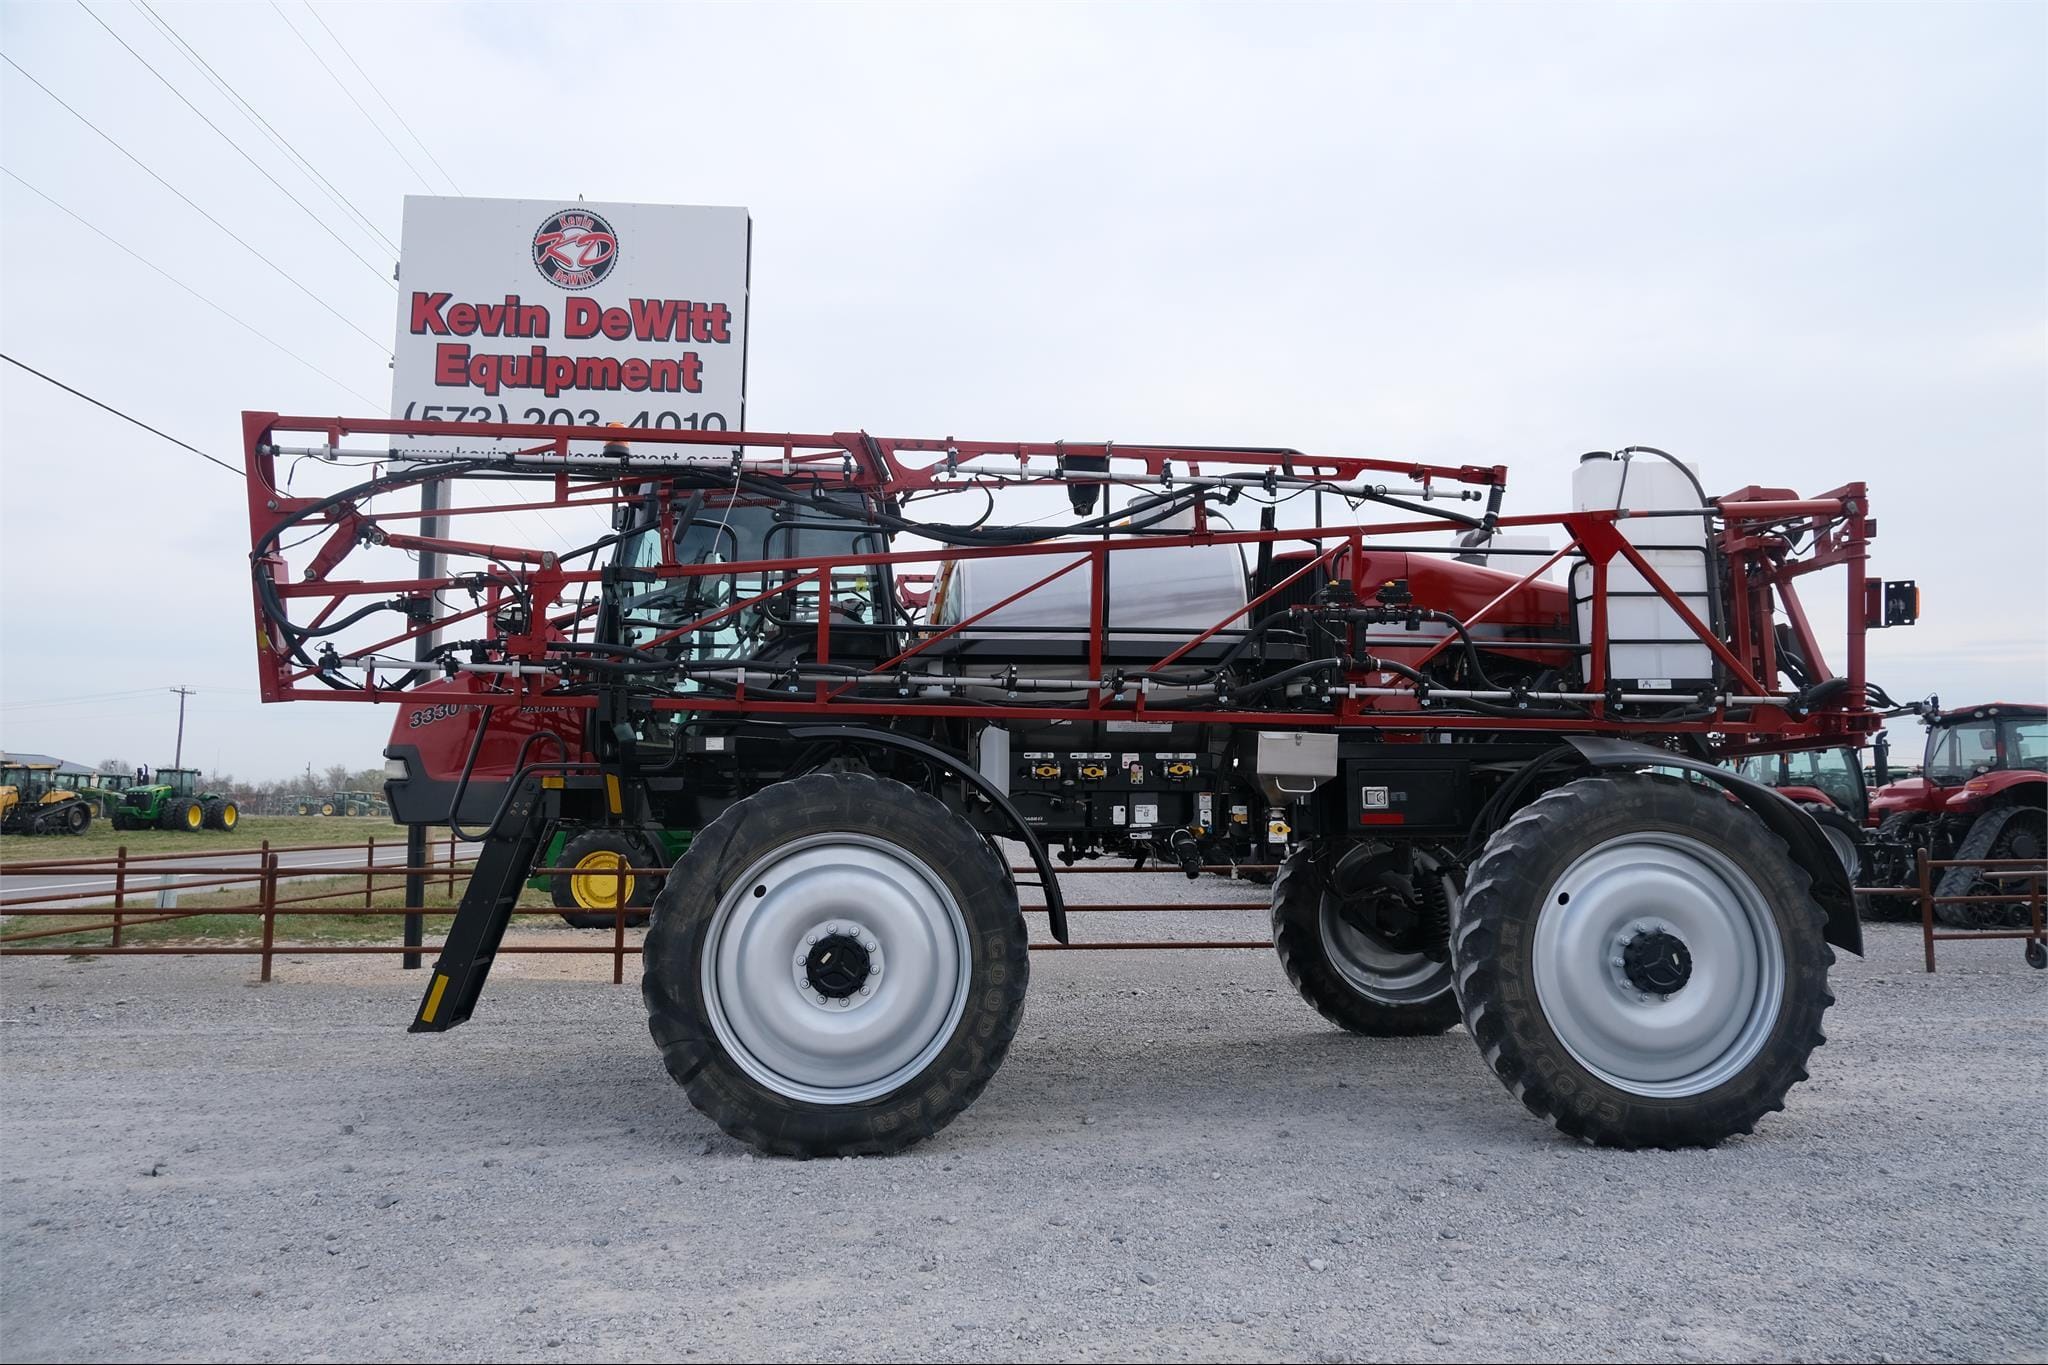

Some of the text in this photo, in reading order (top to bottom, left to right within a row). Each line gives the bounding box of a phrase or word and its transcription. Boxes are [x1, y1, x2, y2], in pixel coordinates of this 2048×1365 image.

[559, 215, 595, 229] Kevin
[535, 231, 617, 268] KD
[553, 268, 597, 286] DeWitt
[410, 291, 732, 344] Kevin DeWitt
[434, 342, 704, 398] Equipment
[409, 703, 462, 729] 3330
[872, 934, 1009, 1134] GOODYEAR
[1498, 922, 1622, 1124] GOODYEAR
